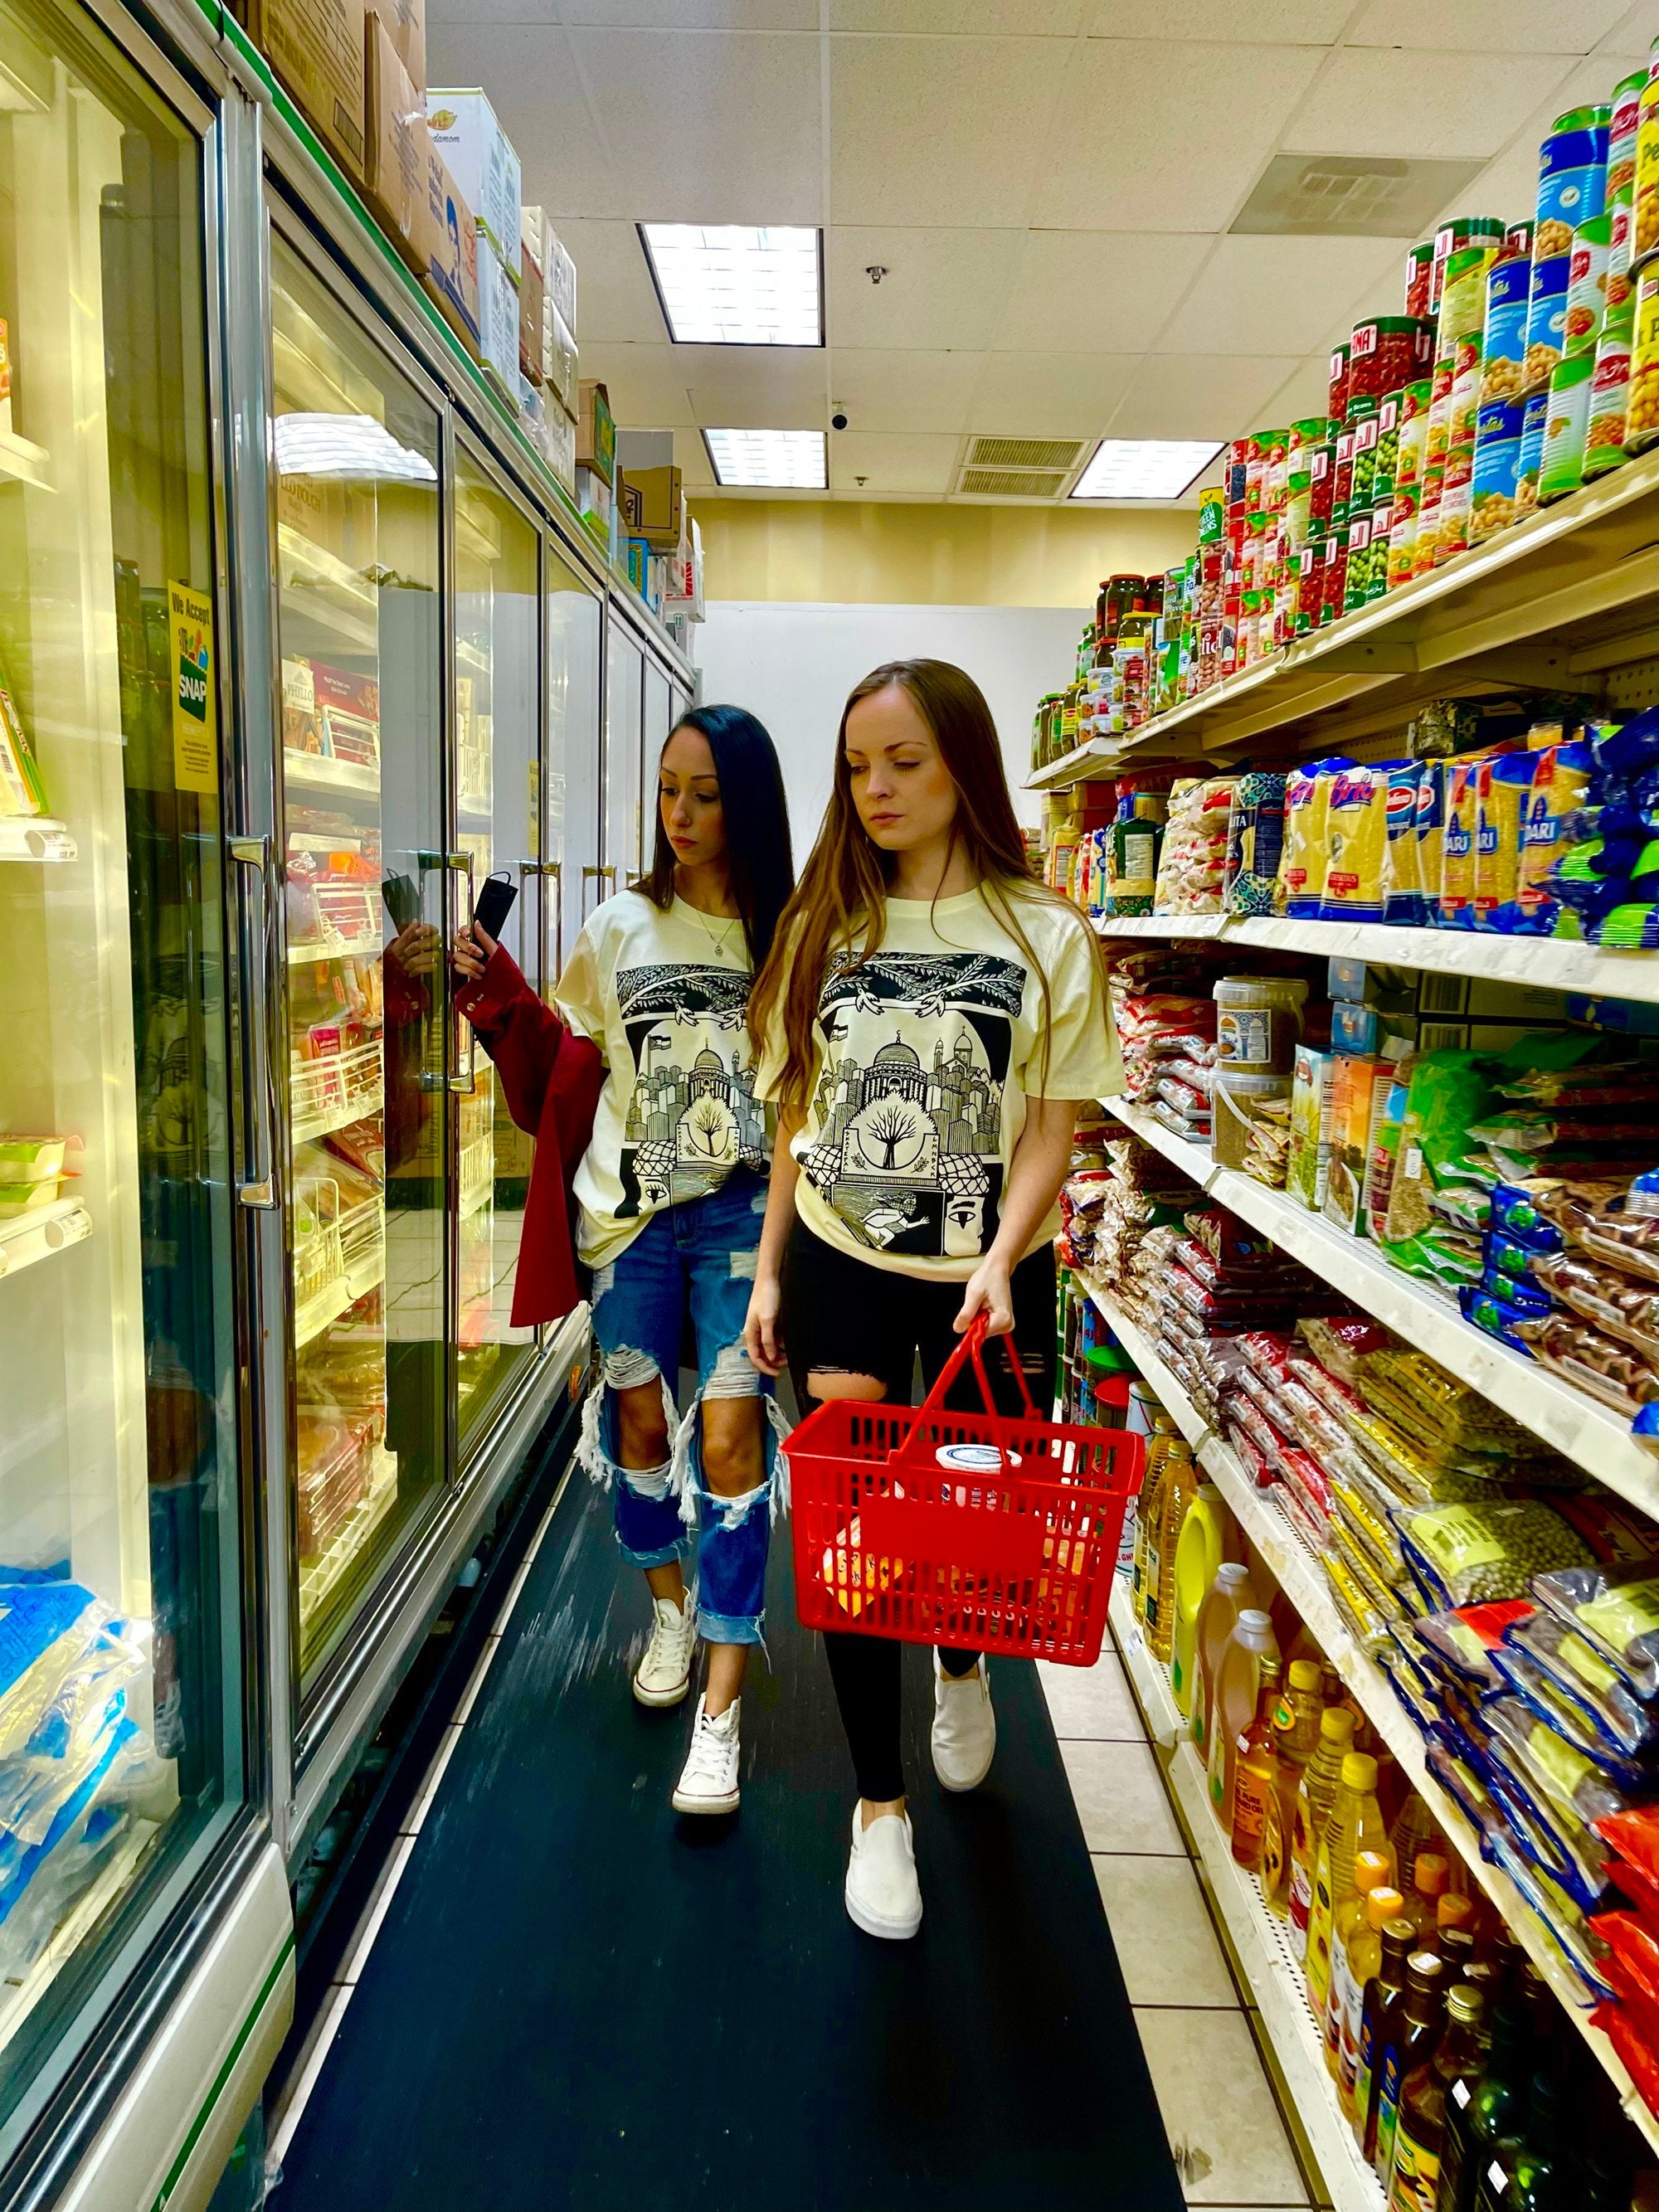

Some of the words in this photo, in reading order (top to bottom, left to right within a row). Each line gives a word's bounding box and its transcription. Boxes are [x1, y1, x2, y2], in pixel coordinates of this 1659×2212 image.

[432, 134, 460, 143] damom
[172, 592, 184, 615] We
[186, 598, 211, 626] Accept
[179, 674, 207, 702] SNAP
[287, 684, 314, 702] PHILLO
[843, 1130, 851, 1173] SKATEPAL
